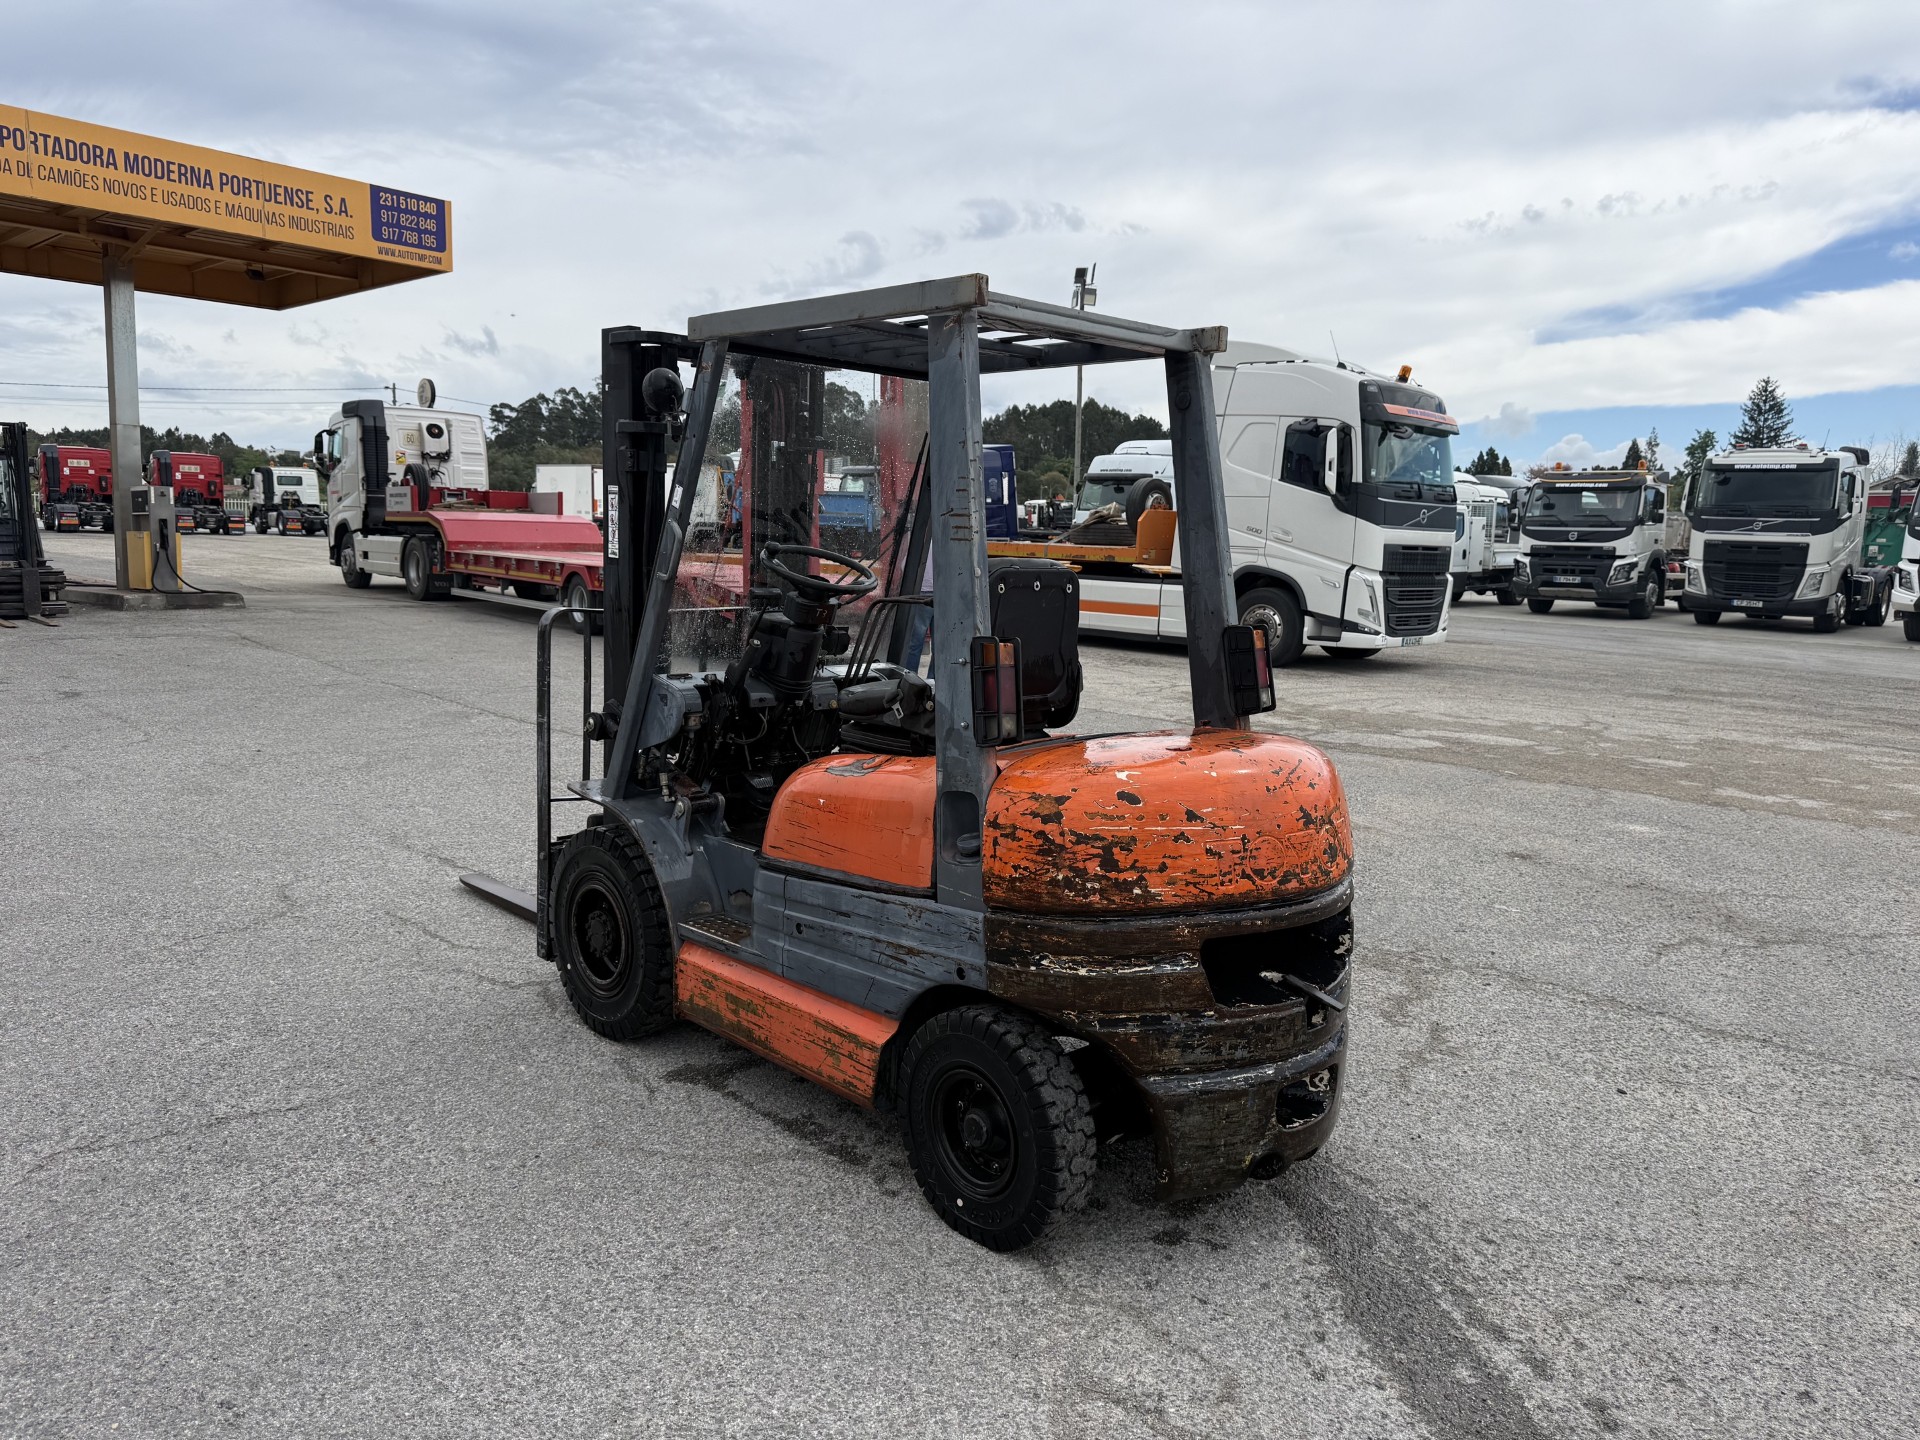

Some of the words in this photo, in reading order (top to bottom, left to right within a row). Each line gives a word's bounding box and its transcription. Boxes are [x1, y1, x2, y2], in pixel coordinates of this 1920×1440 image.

[123, 151, 214, 190] MODERNA
[219, 171, 320, 215] PORTUENSE,
[323, 194, 354, 218] S.A.
[37, 164, 99, 191] CAMIÕES
[102, 177, 147, 201] NOVOS
[150, 187, 158, 203] E
[161, 190, 211, 213] USADOS
[214, 200, 222, 215] E
[225, 202, 285, 228] MÁQUINAS
[288, 215, 355, 240] INDUSTRIAIS
[379, 192, 397, 207] 231
[399, 196, 417, 211] 510
[418, 200, 437, 215] 840
[381, 210, 397, 224] 917
[400, 213, 418, 229] 822
[418, 217, 437, 232] 846
[381, 227, 398, 241] 917
[401, 230, 418, 245] 768
[420, 233, 437, 248] 195
[377, 245, 442, 266] WWW.AUTOTMP.COM
[1246, 525, 1263, 535] 500
